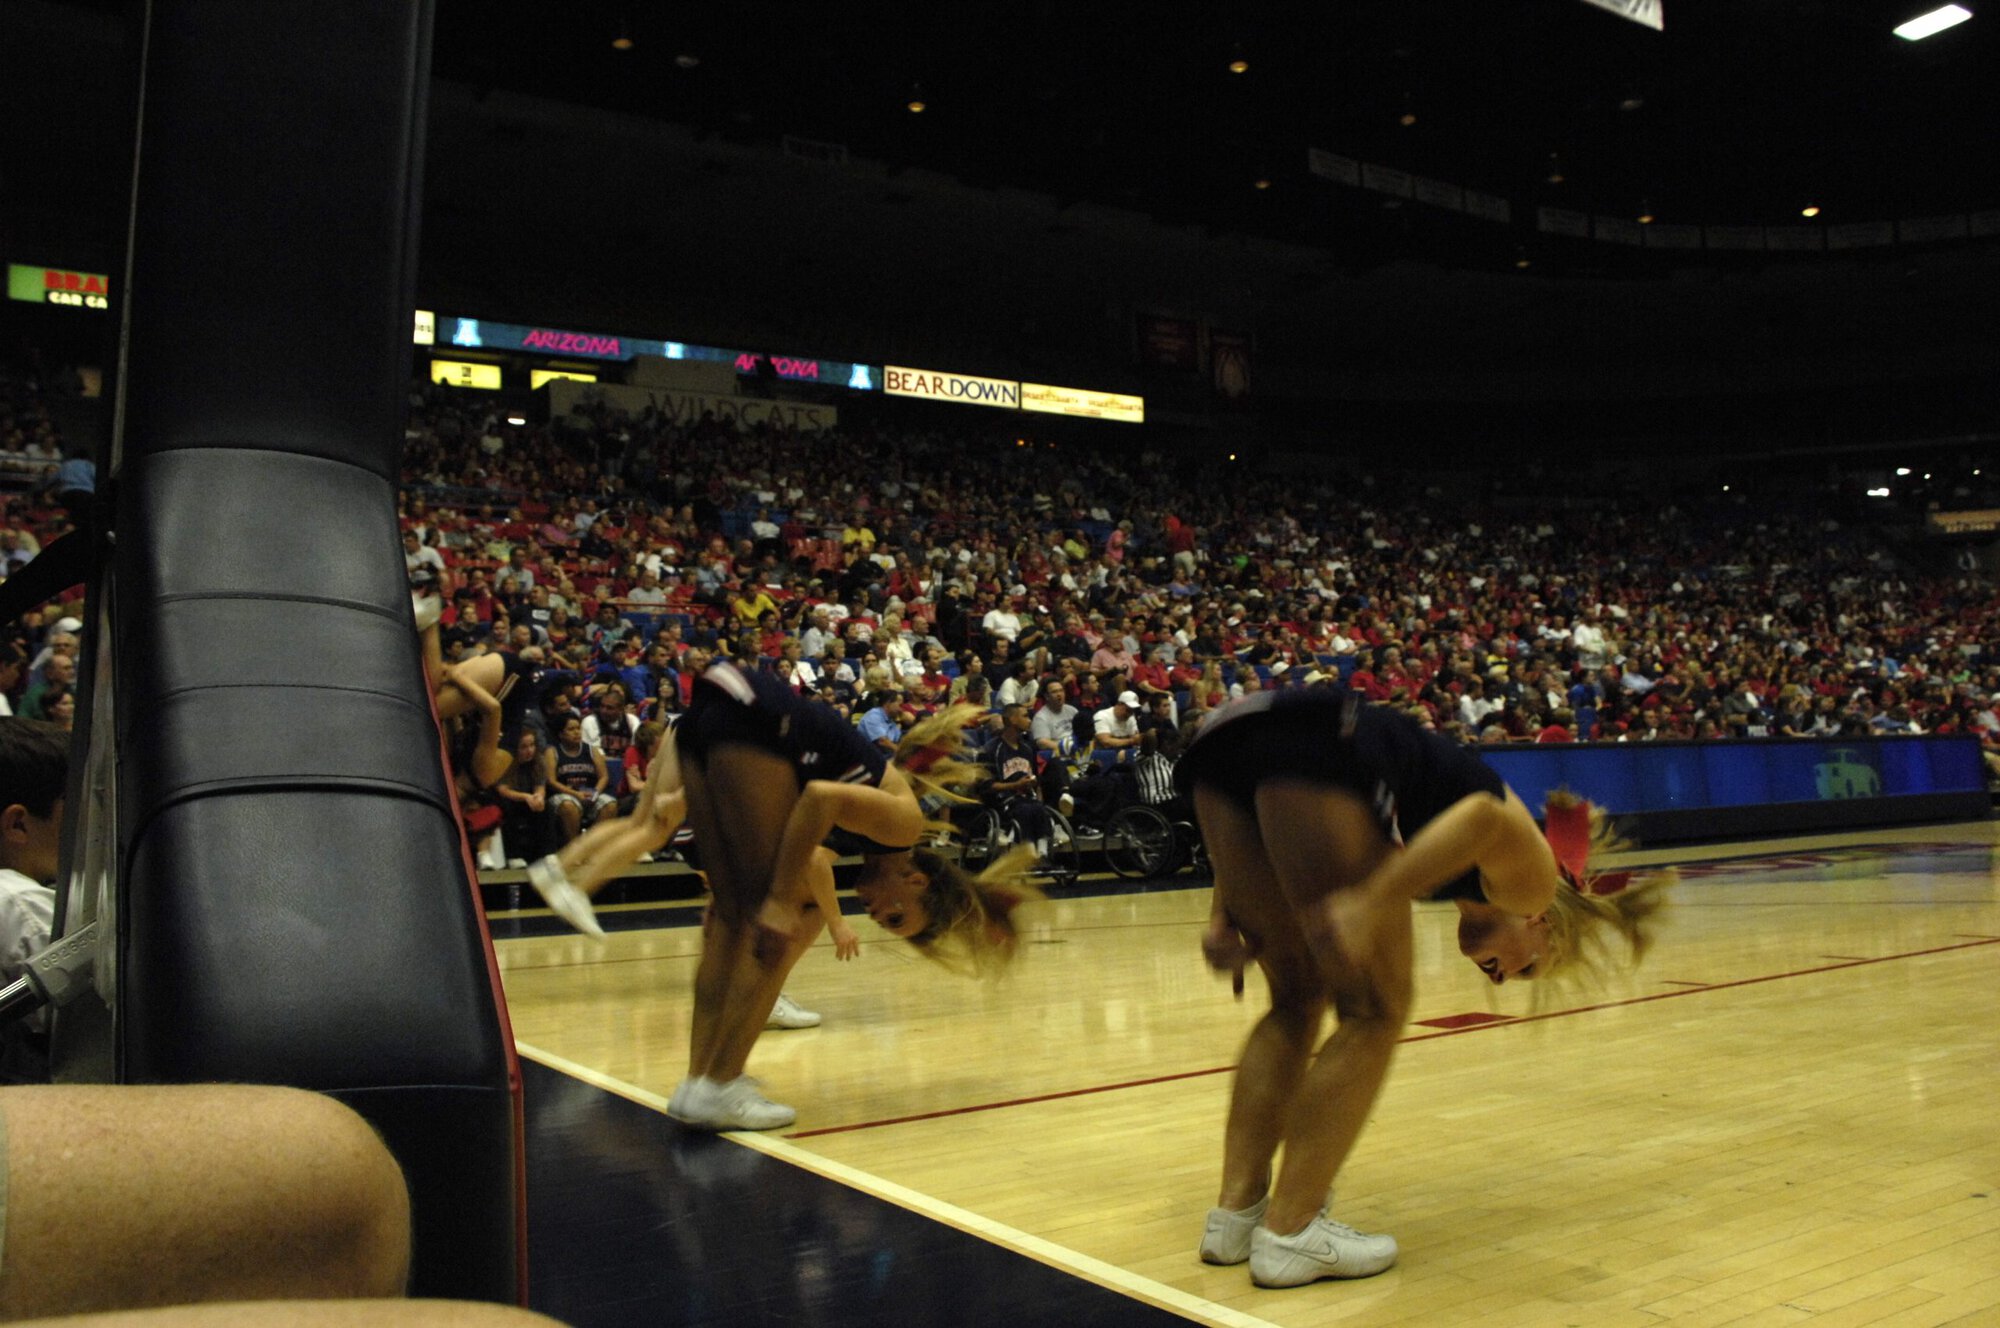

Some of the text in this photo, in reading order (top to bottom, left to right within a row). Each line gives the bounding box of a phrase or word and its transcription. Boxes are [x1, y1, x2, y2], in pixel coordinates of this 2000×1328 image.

[45, 270, 108, 294] BRA
[48, 291, 83, 306] CAR
[523, 329, 620, 355] ARIZONA
[734, 353, 820, 379] ARONA
